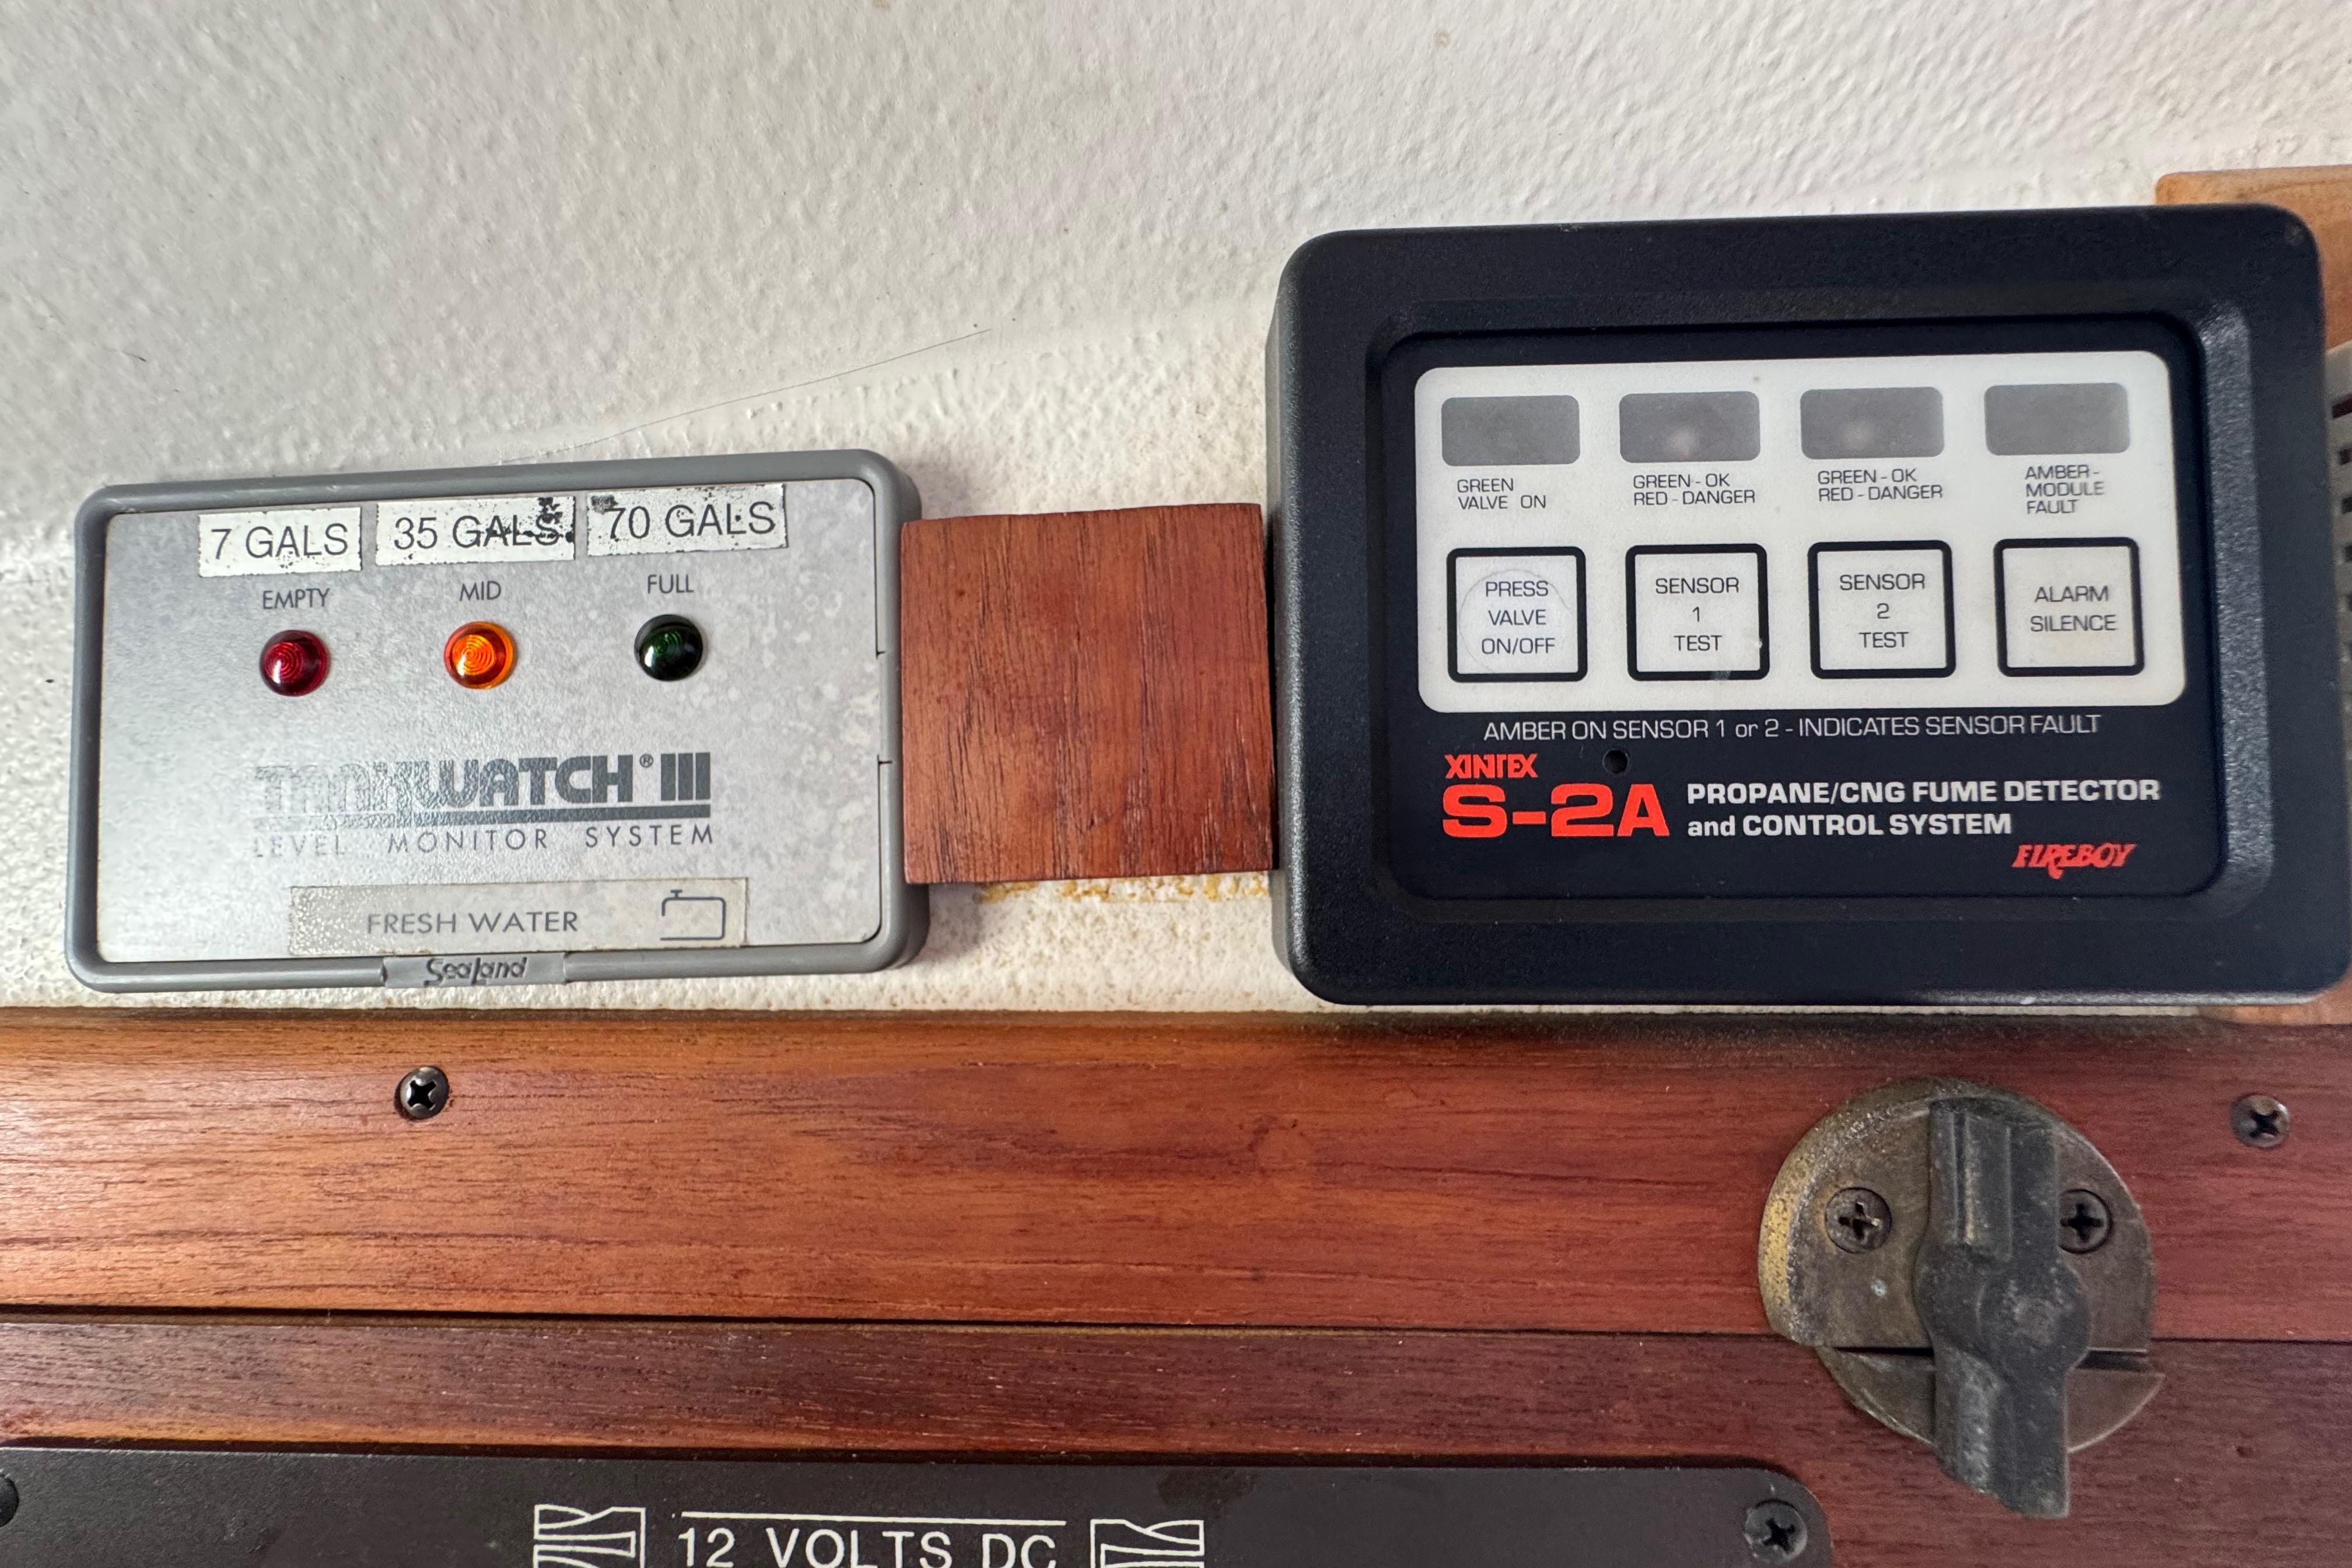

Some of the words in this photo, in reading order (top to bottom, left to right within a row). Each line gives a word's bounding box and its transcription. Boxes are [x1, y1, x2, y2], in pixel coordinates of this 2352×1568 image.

[2025, 481, 2105, 498] MODULE
[1458, 495, 1508, 509] VALVE
[1520, 494, 1546, 509] ON
[2027, 499, 2079, 514] FAULT
[604, 505, 650, 539] 70
[664, 501, 775, 537] GALS
[211, 528, 232, 560] 7
[246, 523, 348, 558] GALS
[394, 517, 438, 550] 35
[452, 515, 559, 547] GALS
[459, 581, 502, 601] MID
[647, 574, 694, 594] FULL
[1485, 580, 1549, 597] PRESS
[1655, 577, 1740, 594] SENSOR
[1839, 573, 1926, 590] SENSOR
[262, 588, 330, 610] EMPTY
[2034, 586, 2109, 603] ALARM
[1488, 609, 1547, 626] VALVE
[1692, 607, 1700, 622] 1
[1877, 603, 1890, 619] 2
[2030, 615, 2118, 632] SILENCE
[1480, 638, 1556, 655] ON/OFF
[1674, 635, 1723, 652] TEST
[1859, 632, 1909, 649] TEST
[1572, 721, 1606, 740] ON
[1613, 720, 1709, 739] SENSOR
[1716, 720, 1725, 738] 1
[1735, 723, 1758, 738] or
[1765, 719, 1780, 737] 2
[1799, 716, 1920, 737] INDICATES
[1926, 715, 2025, 735] SENSOR
[2031, 715, 2102, 733] FAULT
[1444, 754, 1538, 779] XINTEX
[1687, 782, 1906, 804] PROPANE/CNG
[1913, 781, 1998, 803] FUME
[2004, 779, 2161, 802] DETECTOR
[1443, 783, 1670, 838] S-2A
[1688, 816, 1736, 836] and
[1742, 814, 1885, 836] CONTROL
[1889, 813, 2013, 835] SYSTEM
[387, 828, 547, 854] MONITOR
[585, 824, 713, 849] SYSTEM
[2011, 842, 2138, 880] FIREBOY
[367, 913, 456, 935] FRESH
[467, 911, 578, 933] WATER
[678, 1527, 735, 1568] 12
[766, 1527, 953, 1568] VOLTS
[982, 1534, 1057, 1568] DC
